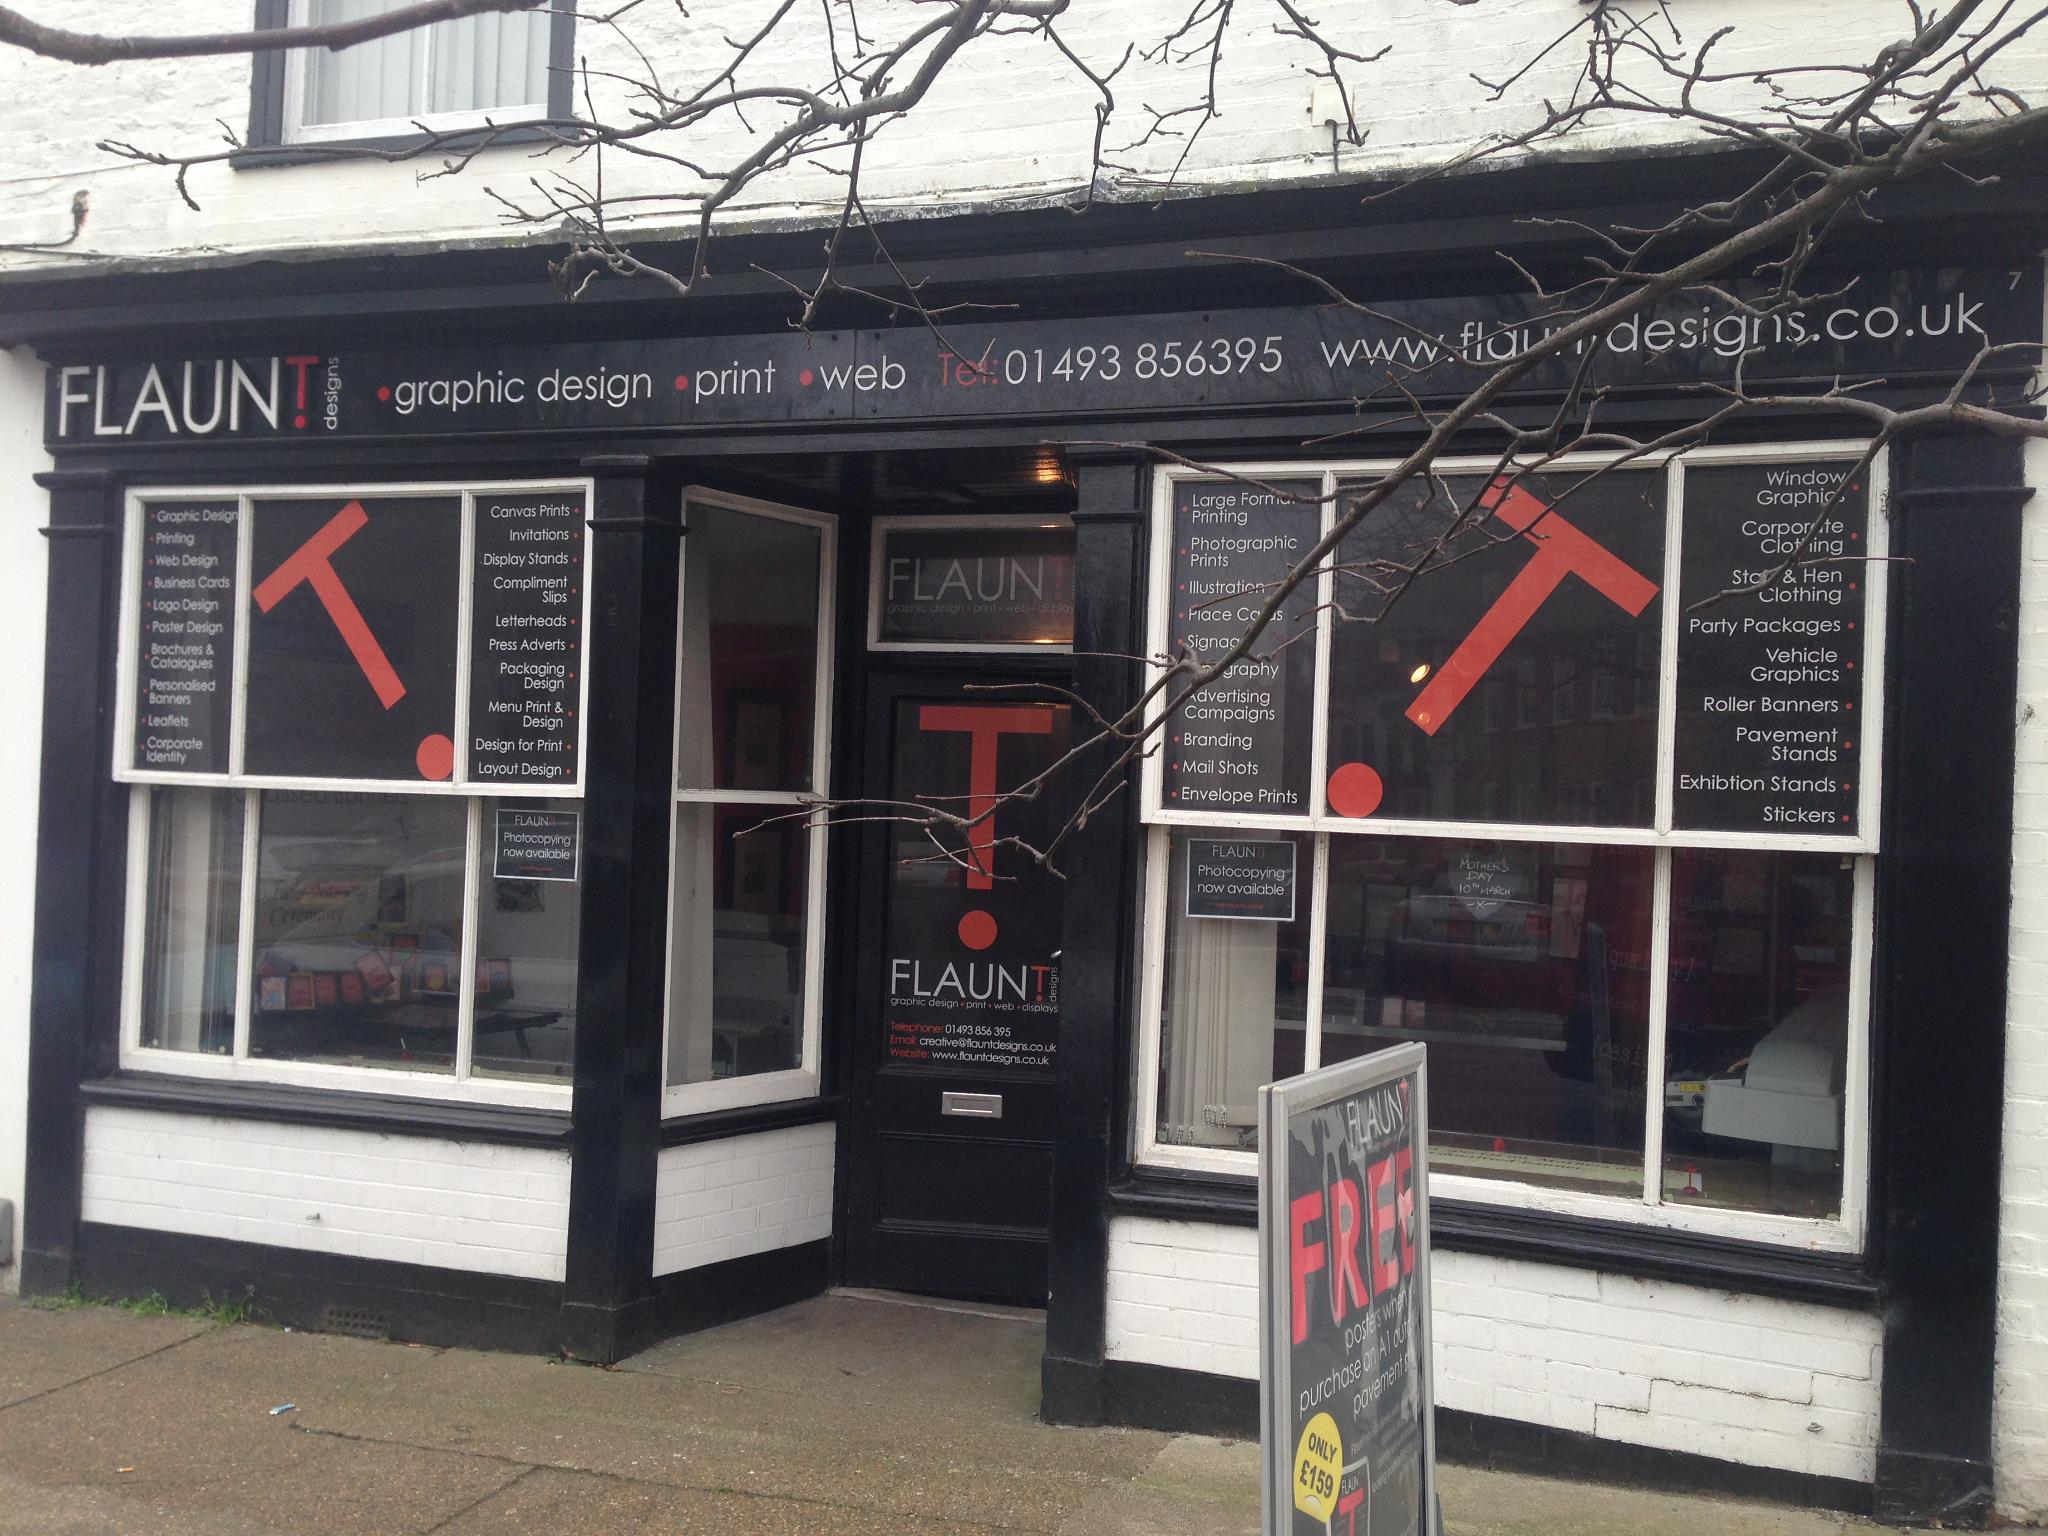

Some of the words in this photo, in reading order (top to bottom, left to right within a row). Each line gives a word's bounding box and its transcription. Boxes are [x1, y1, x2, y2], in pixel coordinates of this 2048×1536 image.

[2008, 271, 2022, 291] 7
[1004, 344, 1121, 386] 01493
[1134, 336, 1284, 379] 856395
[695, 358, 776, 403] print
[819, 355, 906, 392] web
[325, 356, 340, 430] designs
[394, 370, 526, 415] graphic
[537, 366, 653, 408] design
[1766, 470, 1846, 486] Window
[1192, 493, 1237, 510] Large
[156, 509, 200, 523] Graphic
[202, 508, 239, 523] Design
[490, 505, 537, 518] Canvas
[539, 504, 570, 517] Prints
[1192, 509, 1248, 526] Printing
[155, 532, 195, 547] Printing
[509, 529, 570, 541] Invitations
[1190, 535, 1298, 553] Photographic
[155, 554, 180, 566] Web
[182, 553, 219, 568] Design
[483, 553, 525, 567] Display
[528, 552, 569, 565] Stands
[1190, 553, 1229, 568] Prints
[154, 576, 195, 588] Business
[198, 576, 230, 588] Cards
[493, 576, 568, 591] Compliment
[1782, 569, 1797, 584] &
[1803, 568, 1843, 583] Hen
[1189, 580, 1265, 595] Illustration
[542, 590, 568, 605] Slips
[1758, 587, 1842, 605] Clothing
[153, 599, 180, 613] Logo
[182, 598, 218, 613] Design
[1039, 602, 1075, 615] display
[152, 620, 184, 633] Poster
[186, 620, 223, 635] Design
[495, 614, 567, 627] Letterheads
[1689, 618, 1738, 636] Party
[1743, 617, 1841, 635] Packages
[151, 642, 203, 656] Brochures
[205, 643, 214, 655] &
[488, 638, 518, 651] Press
[520, 638, 566, 651] Adverts
[150, 656, 213, 671] Catalogues
[1766, 648, 1838, 663] Vehicle
[500, 662, 565, 677] Packaging
[1750, 666, 1840, 685] Graphics
[149, 678, 216, 692] Personalised
[524, 677, 565, 692] Design
[149, 692, 192, 704] Banners
[1703, 696, 1756, 712] Roller
[1761, 697, 1839, 713] Banners
[488, 701, 523, 713] Menu
[525, 700, 551, 713] Print
[554, 701, 564, 713] &
[1184, 705, 1276, 724] Campaigns
[148, 714, 189, 727] Leaflets
[523, 715, 563, 731] Design
[1183, 732, 1253, 750] Branding
[1736, 727, 1838, 743] Pavement
[147, 736, 203, 751] Corporate
[475, 738, 515, 753] Design
[518, 738, 535, 751] for
[537, 739, 563, 752] Print
[146, 750, 186, 765] Identity
[1771, 745, 1837, 762] Stands
[478, 762, 519, 776] Layout
[521, 762, 562, 778] Design
[1182, 760, 1214, 774] Mail
[1218, 760, 1259, 775] Shots
[1680, 774, 1765, 791] Exhibtion
[1770, 776, 1836, 793] Stands
[1181, 787, 1254, 804] Envelope
[1258, 789, 1298, 804] Prints
[1763, 806, 1836, 823] Stickers
[503, 832, 571, 847] Photocopying
[503, 848, 524, 857] now
[525, 848, 570, 860] available
[1198, 864, 1285, 881] Photocopying
[1197, 883, 1224, 893] now
[1227, 883, 1285, 896] available
[1049, 966, 1060, 1003] designs
[890, 996, 927, 1008] graphic
[928, 997, 959, 1009] design
[966, 1000, 987, 1010] print
[993, 1001, 1015, 1011] web
[1022, 1002, 1059, 1014] displays
[945, 1024, 973, 1036] 01493
[974, 1025, 992, 1036] 856
[993, 1026, 1012, 1037] 395
[919, 1036, 1057, 1053] creative@flauntdesigns.co.uk
[931, 1050, 1050, 1066] www.flauntdesigns.co.uk
[1289, 1145, 1415, 1346] FREE
[1300, 1359, 1362, 1421] purchase
[1363, 1347, 1378, 1372] an
[1353, 1356, 1403, 1422] pavement
[1308, 1432, 1338, 1463] ONLY
[1299, 1459, 1334, 1498] £159
